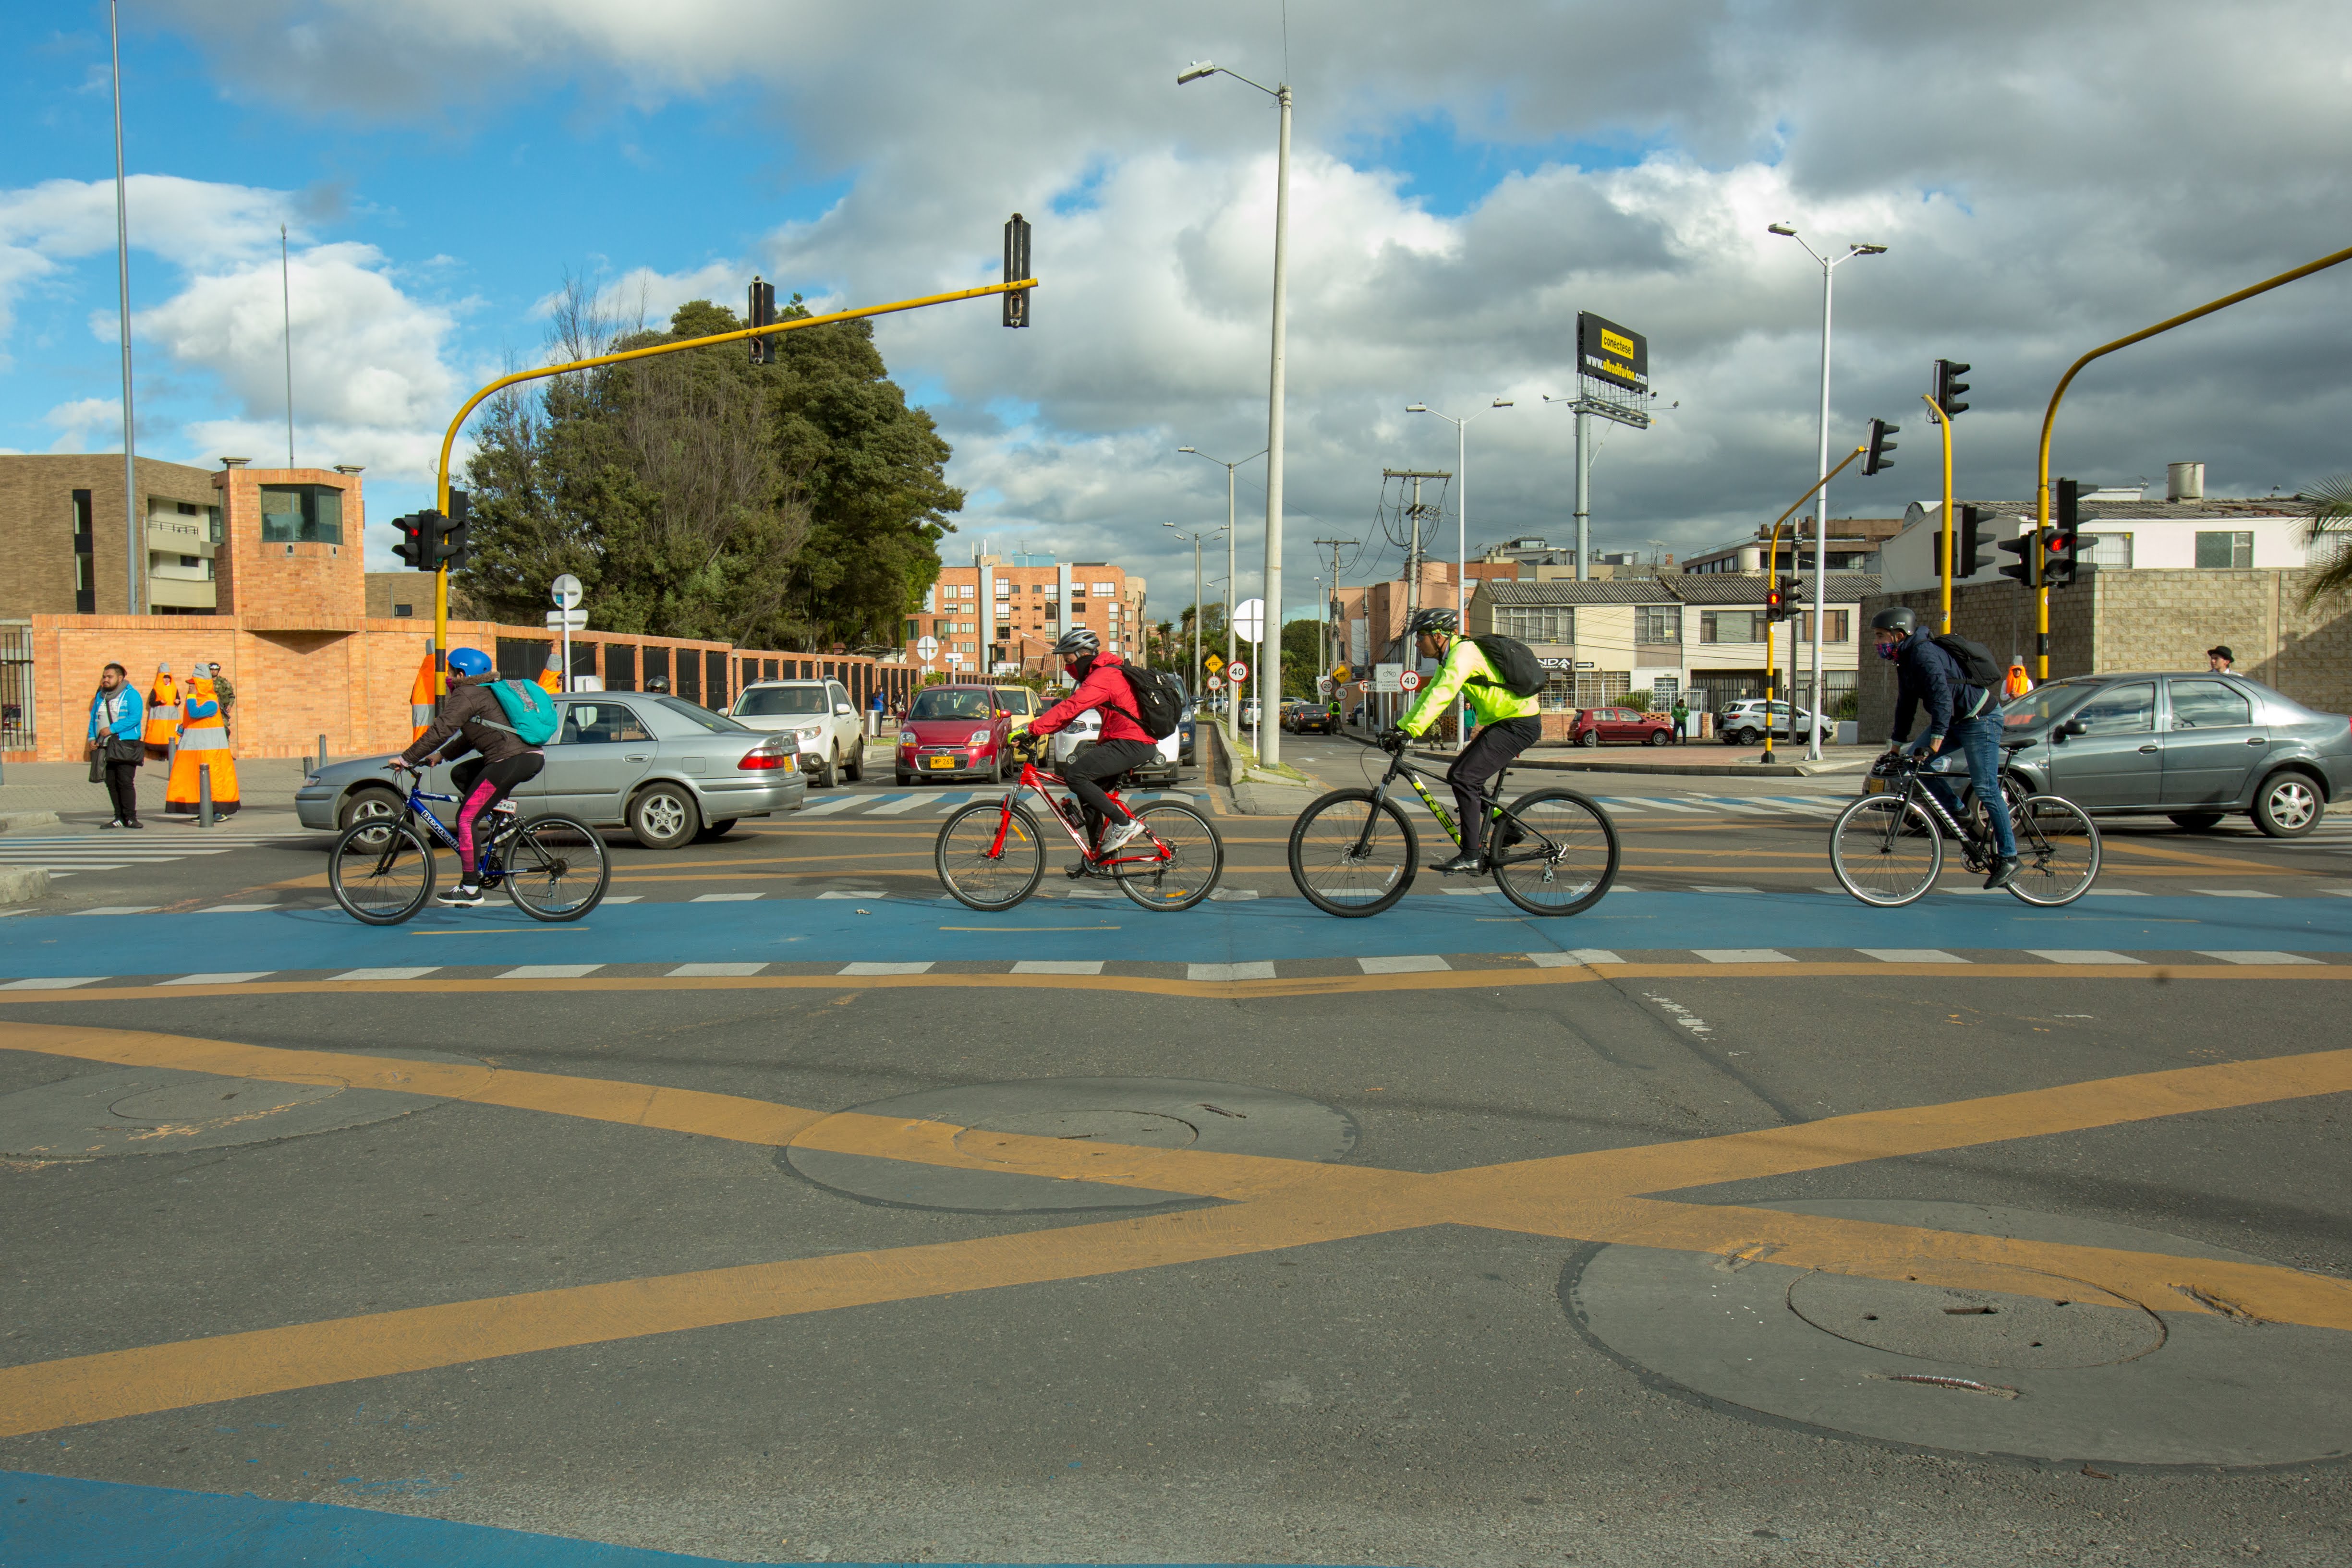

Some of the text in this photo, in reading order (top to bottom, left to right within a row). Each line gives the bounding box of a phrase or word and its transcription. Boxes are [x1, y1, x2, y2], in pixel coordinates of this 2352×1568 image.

[1604, 336, 1631, 355] conéctese
[1586, 354, 1647, 385] www.ultradifusion.com
[1413, 775, 1461, 845] TREK
